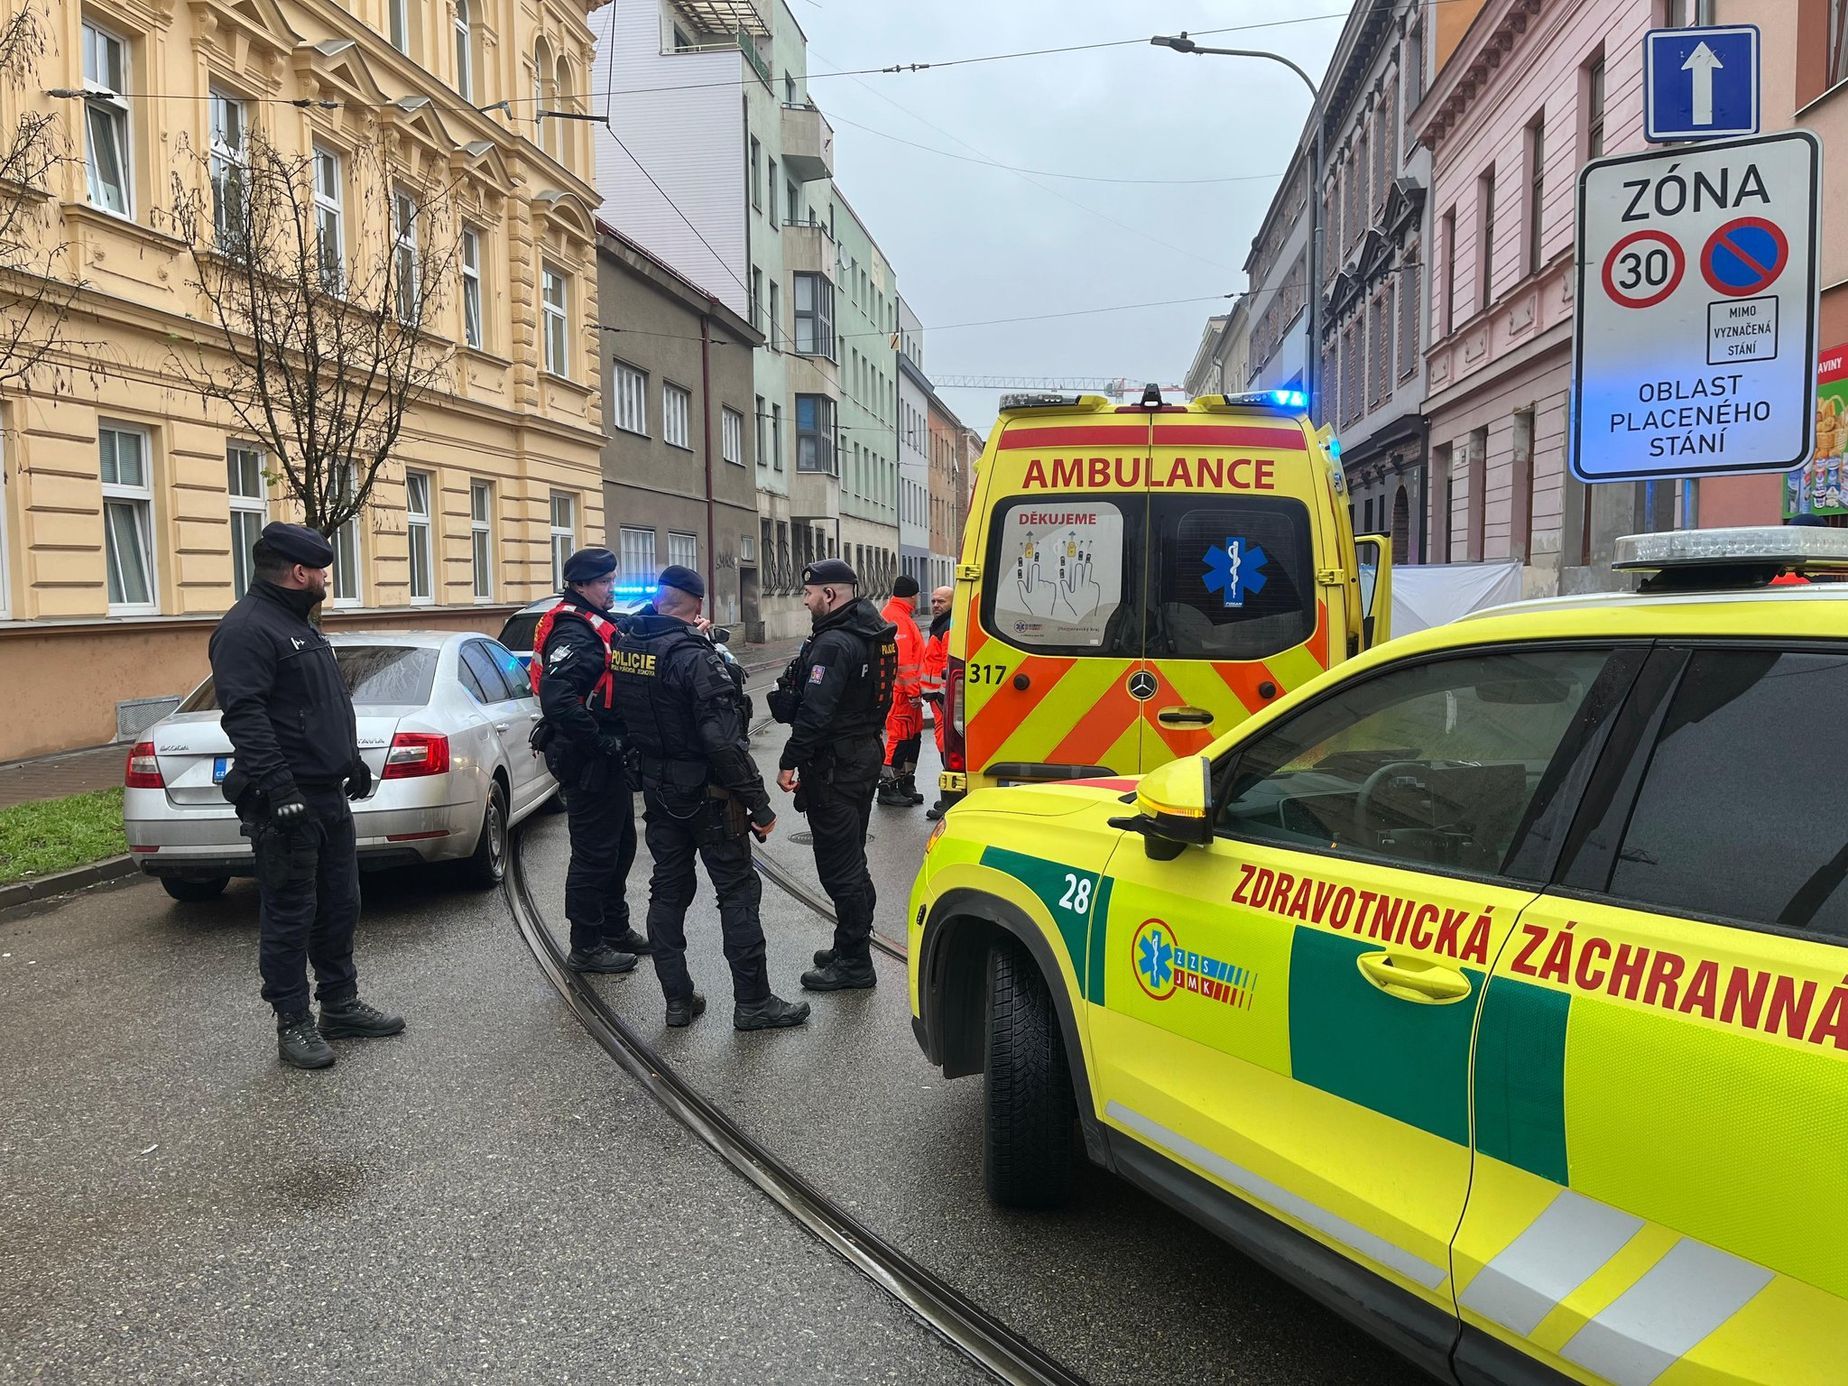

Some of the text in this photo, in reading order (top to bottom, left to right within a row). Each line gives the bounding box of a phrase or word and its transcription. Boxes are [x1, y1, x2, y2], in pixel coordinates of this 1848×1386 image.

[1621, 163, 1771, 222] ZÓNA
[1619, 249, 1668, 289] 30
[1729, 305, 1757, 319] MIMO
[1713, 320, 1772, 339] VYZNAČENÁ
[1727, 341, 1757, 356] STÁNÍ
[1817, 356, 1843, 374] AVINY
[1639, 374, 1744, 403] OBLAST
[1610, 399, 1771, 433] PLACENÉHO
[1649, 427, 1728, 457] STÁNÍ
[1022, 457, 1275, 490] AMBULANCE
[1018, 511, 1097, 526] DĚKUJEME
[611, 649, 657, 670] POLICIE
[969, 663, 1007, 685] 317
[1059, 873, 1091, 914] 28
[1175, 951, 1209, 973] ZZS
[1231, 864, 1848, 1052] ZDRAVOTNICKÁ ZÁCHRANNÁ
[1175, 972, 1210, 994] JMK
